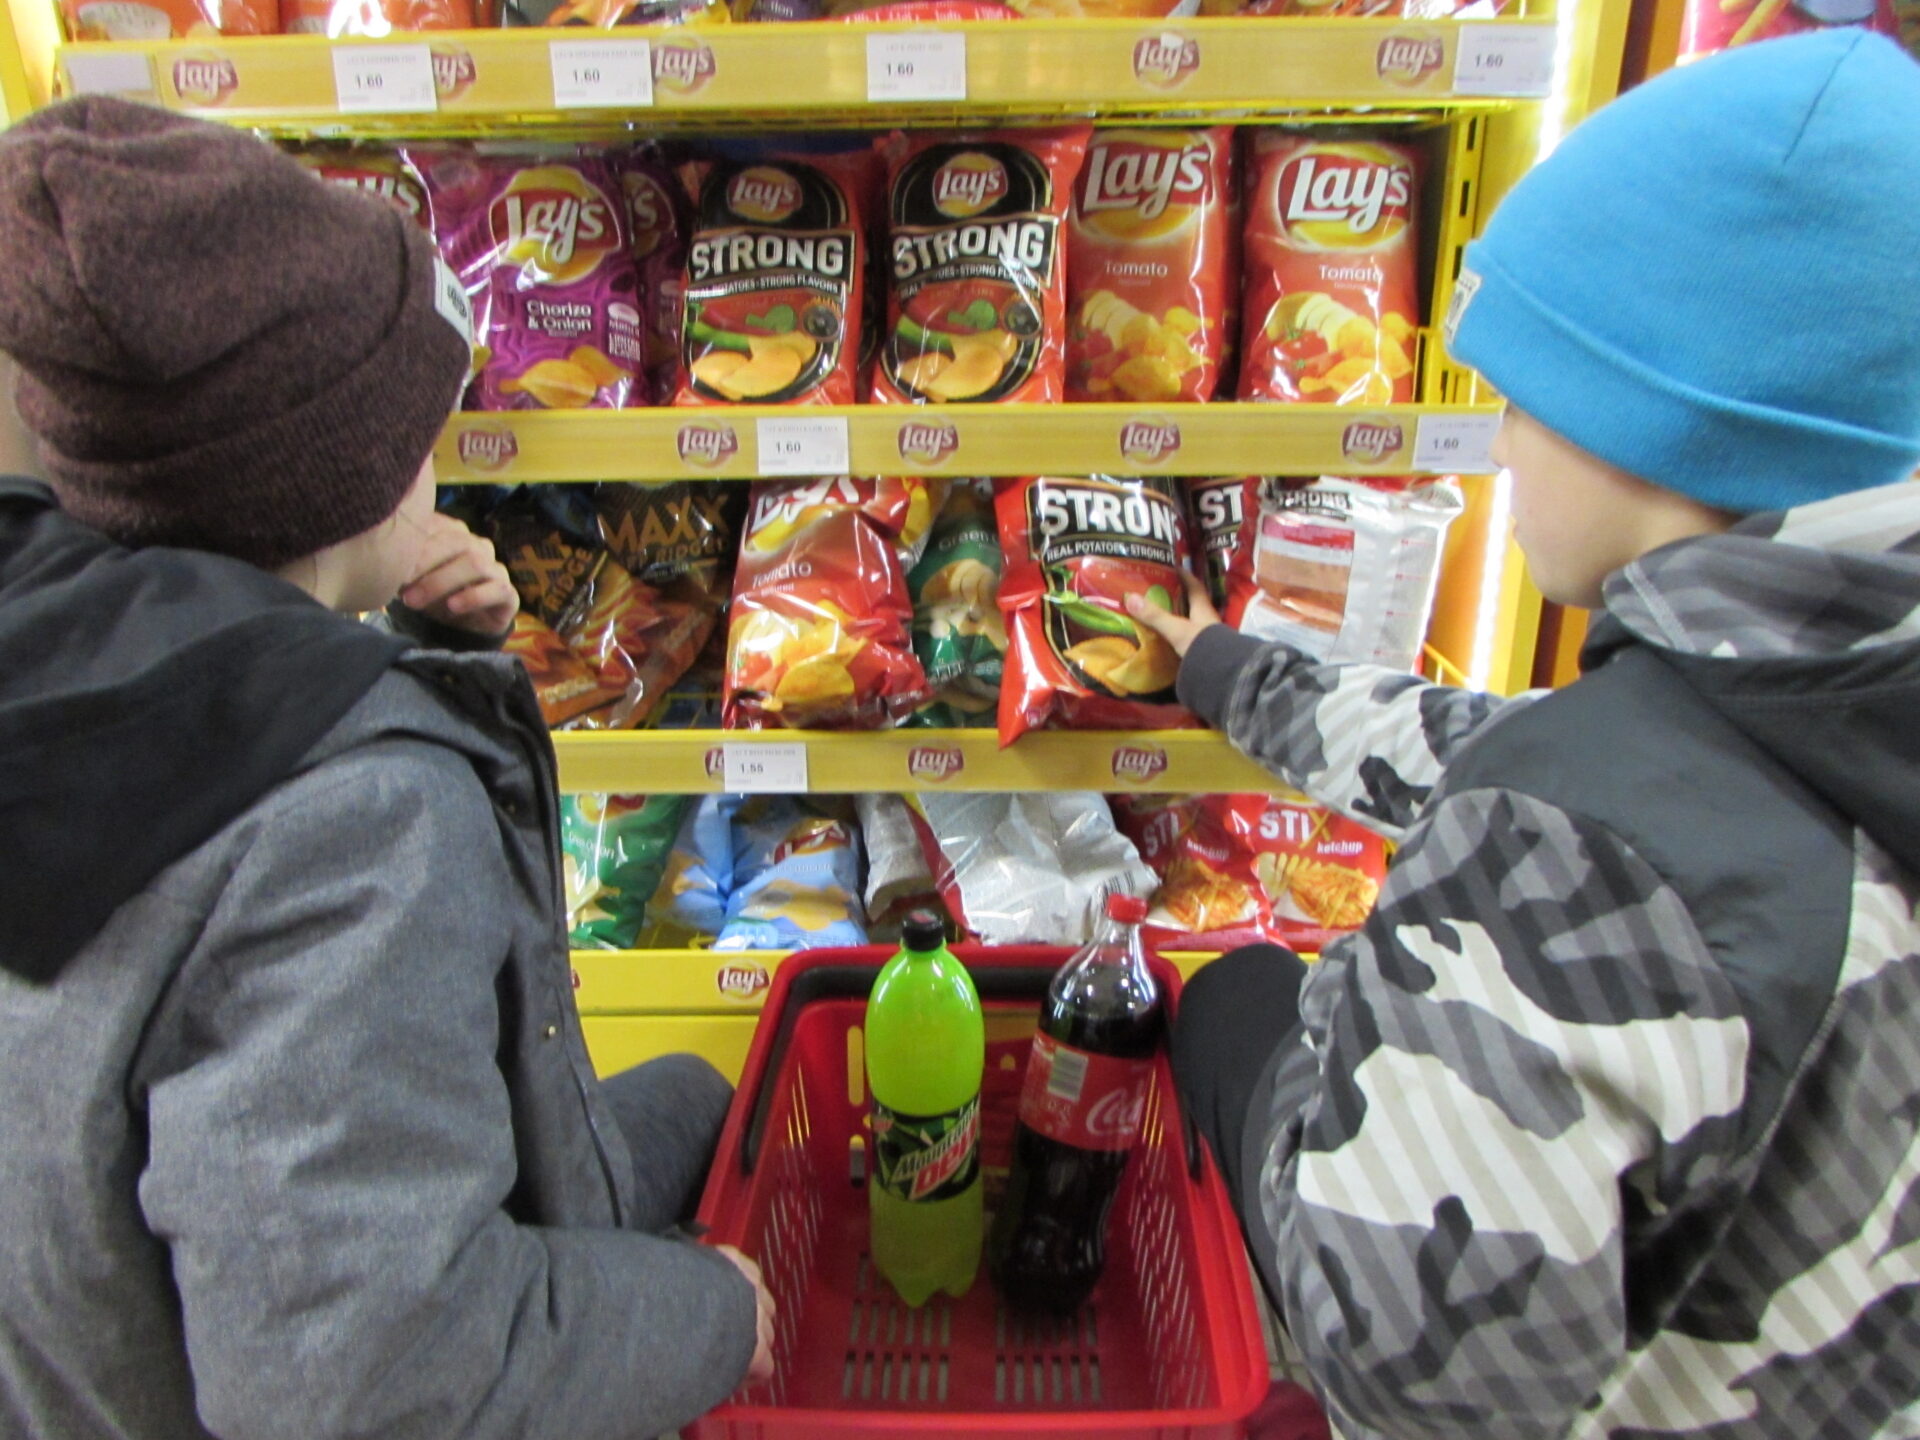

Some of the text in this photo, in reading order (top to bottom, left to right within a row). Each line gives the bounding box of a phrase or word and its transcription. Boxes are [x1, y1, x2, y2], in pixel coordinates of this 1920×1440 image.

[573, 67, 600, 83] 1.60
[886, 62, 914, 76] 1.60
[1083, 144, 1210, 220] Lay's
[1287, 157, 1411, 234] Lay's
[506, 195, 605, 264] Lay's
[691, 234, 844, 280] STRONG
[892, 222, 1046, 280] STRONG
[960, 263, 996, 277] STRONG
[1105, 259, 1168, 278] Tomato
[1319, 263, 1383, 282] Tomato
[760, 276, 796, 290] STRONG
[797, 273, 838, 294] FLAVORS
[527, 299, 592, 317] Chorizo
[543, 316, 592, 332] Onion
[776, 441, 801, 454] 1.60
[1130, 543, 1165, 560] STRONG
[1259, 808, 1332, 850] STIX
[1317, 840, 1364, 856] ketchup
